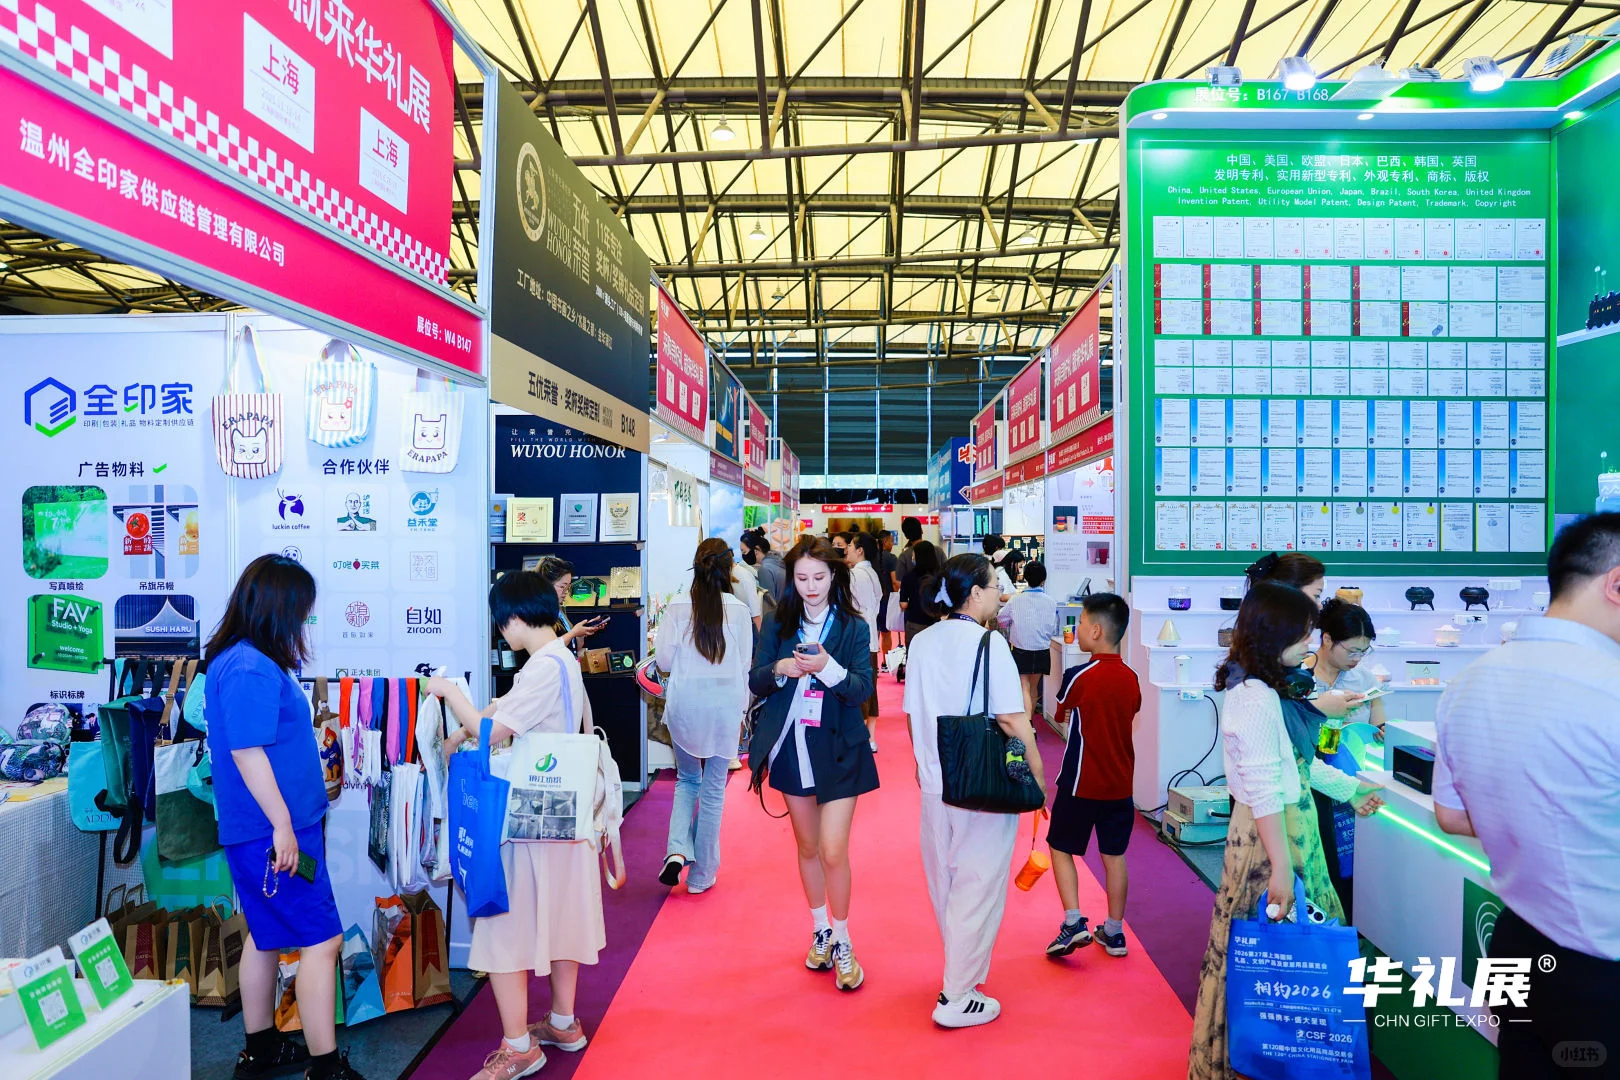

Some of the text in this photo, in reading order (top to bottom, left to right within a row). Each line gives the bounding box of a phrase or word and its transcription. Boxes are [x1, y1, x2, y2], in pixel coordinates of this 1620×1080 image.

[262, 44, 299, 95] 上海
[1257, 88, 1288, 101] B167
[1297, 88, 1329, 101] B168
[372, 128, 398, 168] 上海
[1226, 153, 1477, 167] 中国、美国、欧盟、日本、巴西、韩国、英国
[1214, 169, 1489, 182] 发明专利、实用新型专利、外观专利、商标、版权
[19, 118, 285, 267] 温州全印家供应链管理有限公司
[1200, 186, 1227, 194] United
[1267, 187, 1303, 196] European
[1407, 188, 1430, 196] South
[1498, 189, 1531, 197] Kingdom
[1258, 198, 1290, 206] Utility
[1294, 198, 1316, 206] Model
[1357, 199, 1385, 207] Design
[1475, 199, 1517, 208] Copyright
[547, 207, 572, 248] WUYOU
[546, 229, 572, 270] HONOR
[417, 315, 472, 353] 展位号： W4 B147
[313, 381, 358, 395] ERAPAPA
[83, 382, 193, 416] 全印家
[139, 418, 194, 428] 物料定制供应链
[222, 412, 275, 430] ERAPAPA
[621, 414, 636, 438] B148
[407, 450, 448, 463] ERAPAPA
[511, 444, 626, 459] WUYOU HONOR
[78, 461, 144, 478] 广告物料
[322, 458, 390, 475] 合作伙伴
[407, 518, 438, 527] 益禾堂
[49, 581, 84, 591] 写真喷绘
[406, 607, 442, 625] 自如
[51, 619, 73, 630] Studio
[78, 624, 93, 635] Yoga
[145, 626, 192, 634] SUSHI HARU
[406, 626, 442, 634] ziroom
[59, 645, 85, 654] welcome
[350, 668, 381, 677] 正大集团
[50, 689, 85, 700] 标识标牌
[1254, 979, 1332, 999] 相约2026
[1305, 1031, 1353, 1043] CSF 2026
